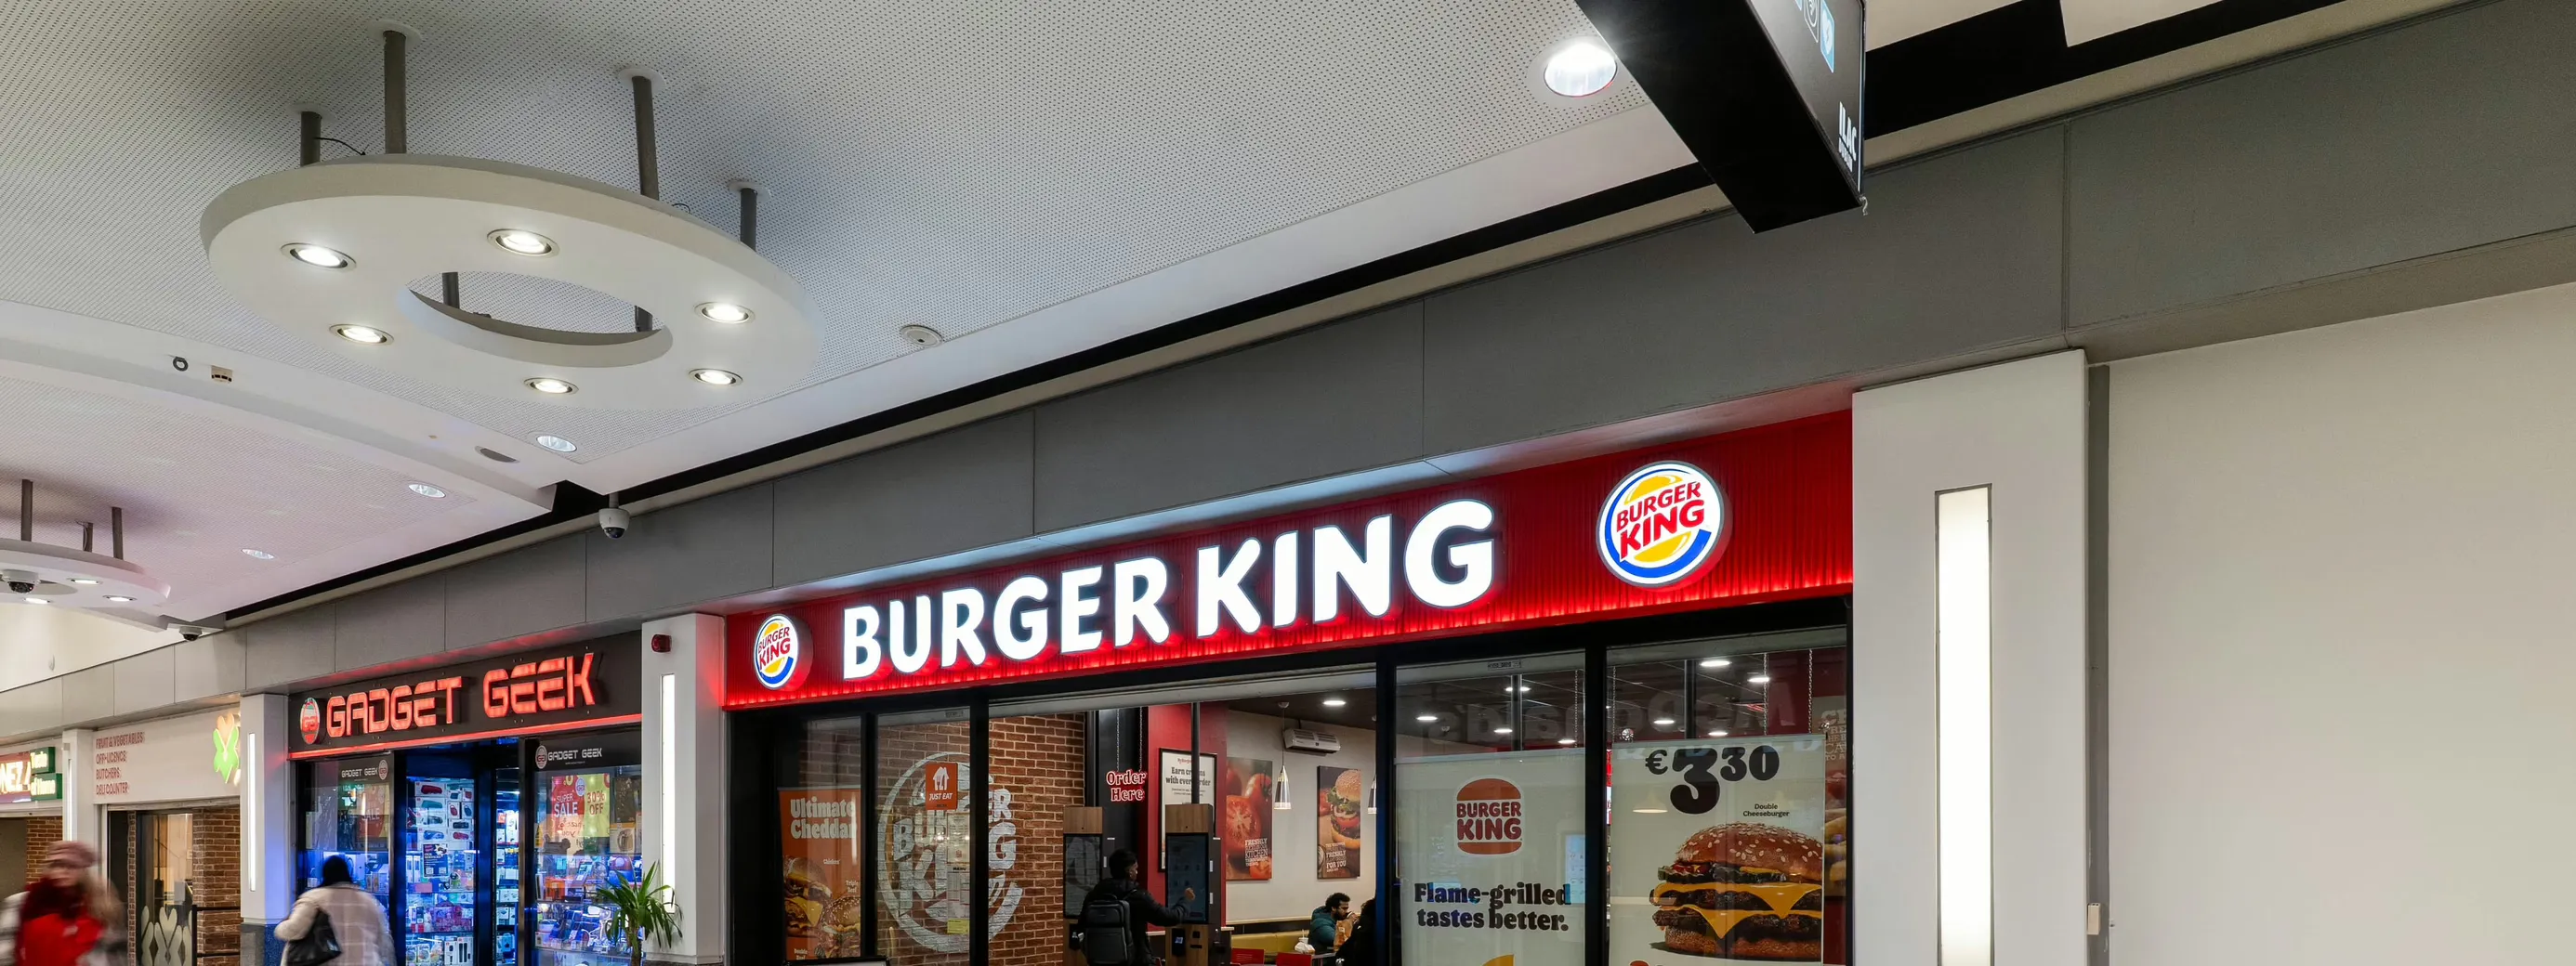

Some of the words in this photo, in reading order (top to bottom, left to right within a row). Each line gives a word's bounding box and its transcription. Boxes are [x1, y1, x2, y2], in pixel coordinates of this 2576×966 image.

[1839, 101, 1857, 162] ILAC
[1617, 482, 1701, 532] BURGER
[1621, 500, 1704, 559] KING
[843, 557, 1171, 680] BURGER
[1197, 500, 1495, 639] KING
[758, 627, 790, 653] BURGER
[758, 638, 791, 671] KING
[327, 676, 463, 738] GADGET
[483, 653, 596, 719] GEEK
[96, 738, 109, 749] FRUIT
[113, 732, 145, 747] VEGETABLES
[547, 750, 579, 761] GADGET
[582, 748, 603, 758] GEEK
[96, 767, 122, 779] BUTCHERS
[341, 768, 362, 777] GADGET
[364, 766, 378, 776] GEEK
[1106, 769, 1148, 786] Order
[1171, 766, 1186, 776] Earn
[106, 782, 129, 794] COUNTER
[1165, 776, 1179, 785] with
[1179, 777, 1191, 786] ever
[1199, 777, 1211, 787] rder
[557, 793, 574, 803] SUPER
[586, 790, 606, 803] 30%
[928, 793, 941, 802] JUST
[1111, 787, 1145, 802] Here
[554, 802, 578, 817] SALE
[589, 803, 604, 815] OFF
[790, 796, 855, 818] Ultimate
[1456, 802, 1521, 818] BURGER
[790, 818, 857, 839] Cheddar
[1457, 818, 1522, 840] KING
[898, 821, 1017, 917] KIG
[1414, 881, 1571, 910] Flame-grilled
[1417, 907, 1484, 928] tastes
[1489, 907, 1569, 932] better.
